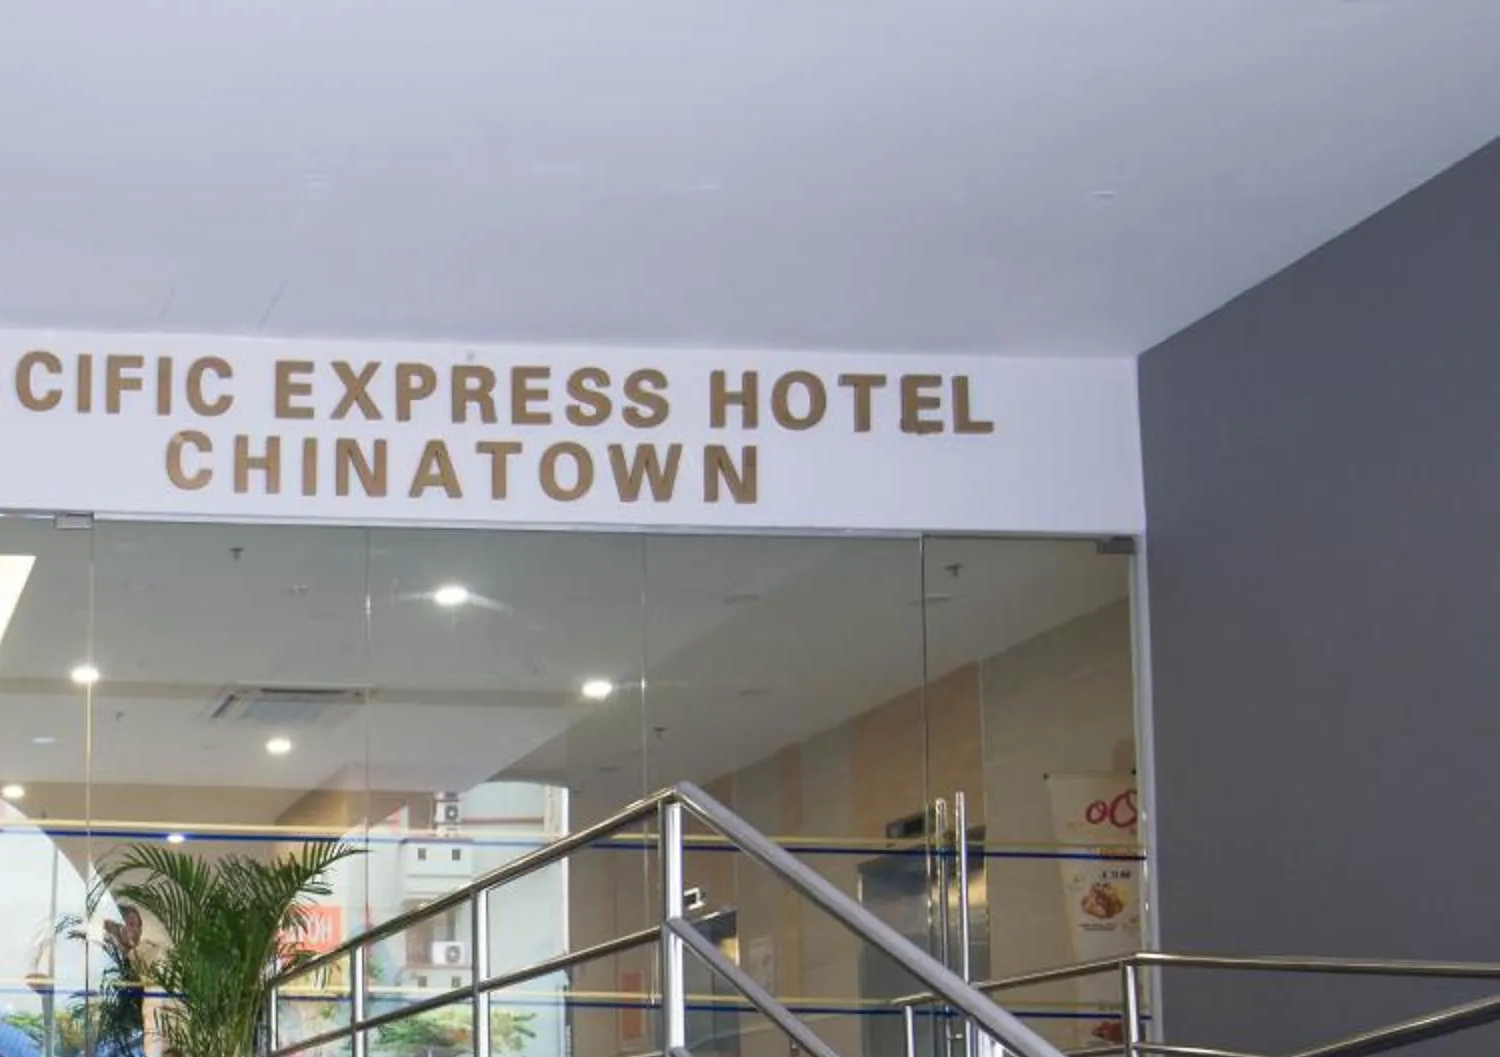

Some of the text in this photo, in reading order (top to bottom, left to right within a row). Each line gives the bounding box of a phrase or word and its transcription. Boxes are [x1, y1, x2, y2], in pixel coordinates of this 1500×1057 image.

[275, 360, 670, 430] EXPRESS
[710, 370, 995, 435] HOTEL
[166, 430, 758, 505] CHINATOWN
